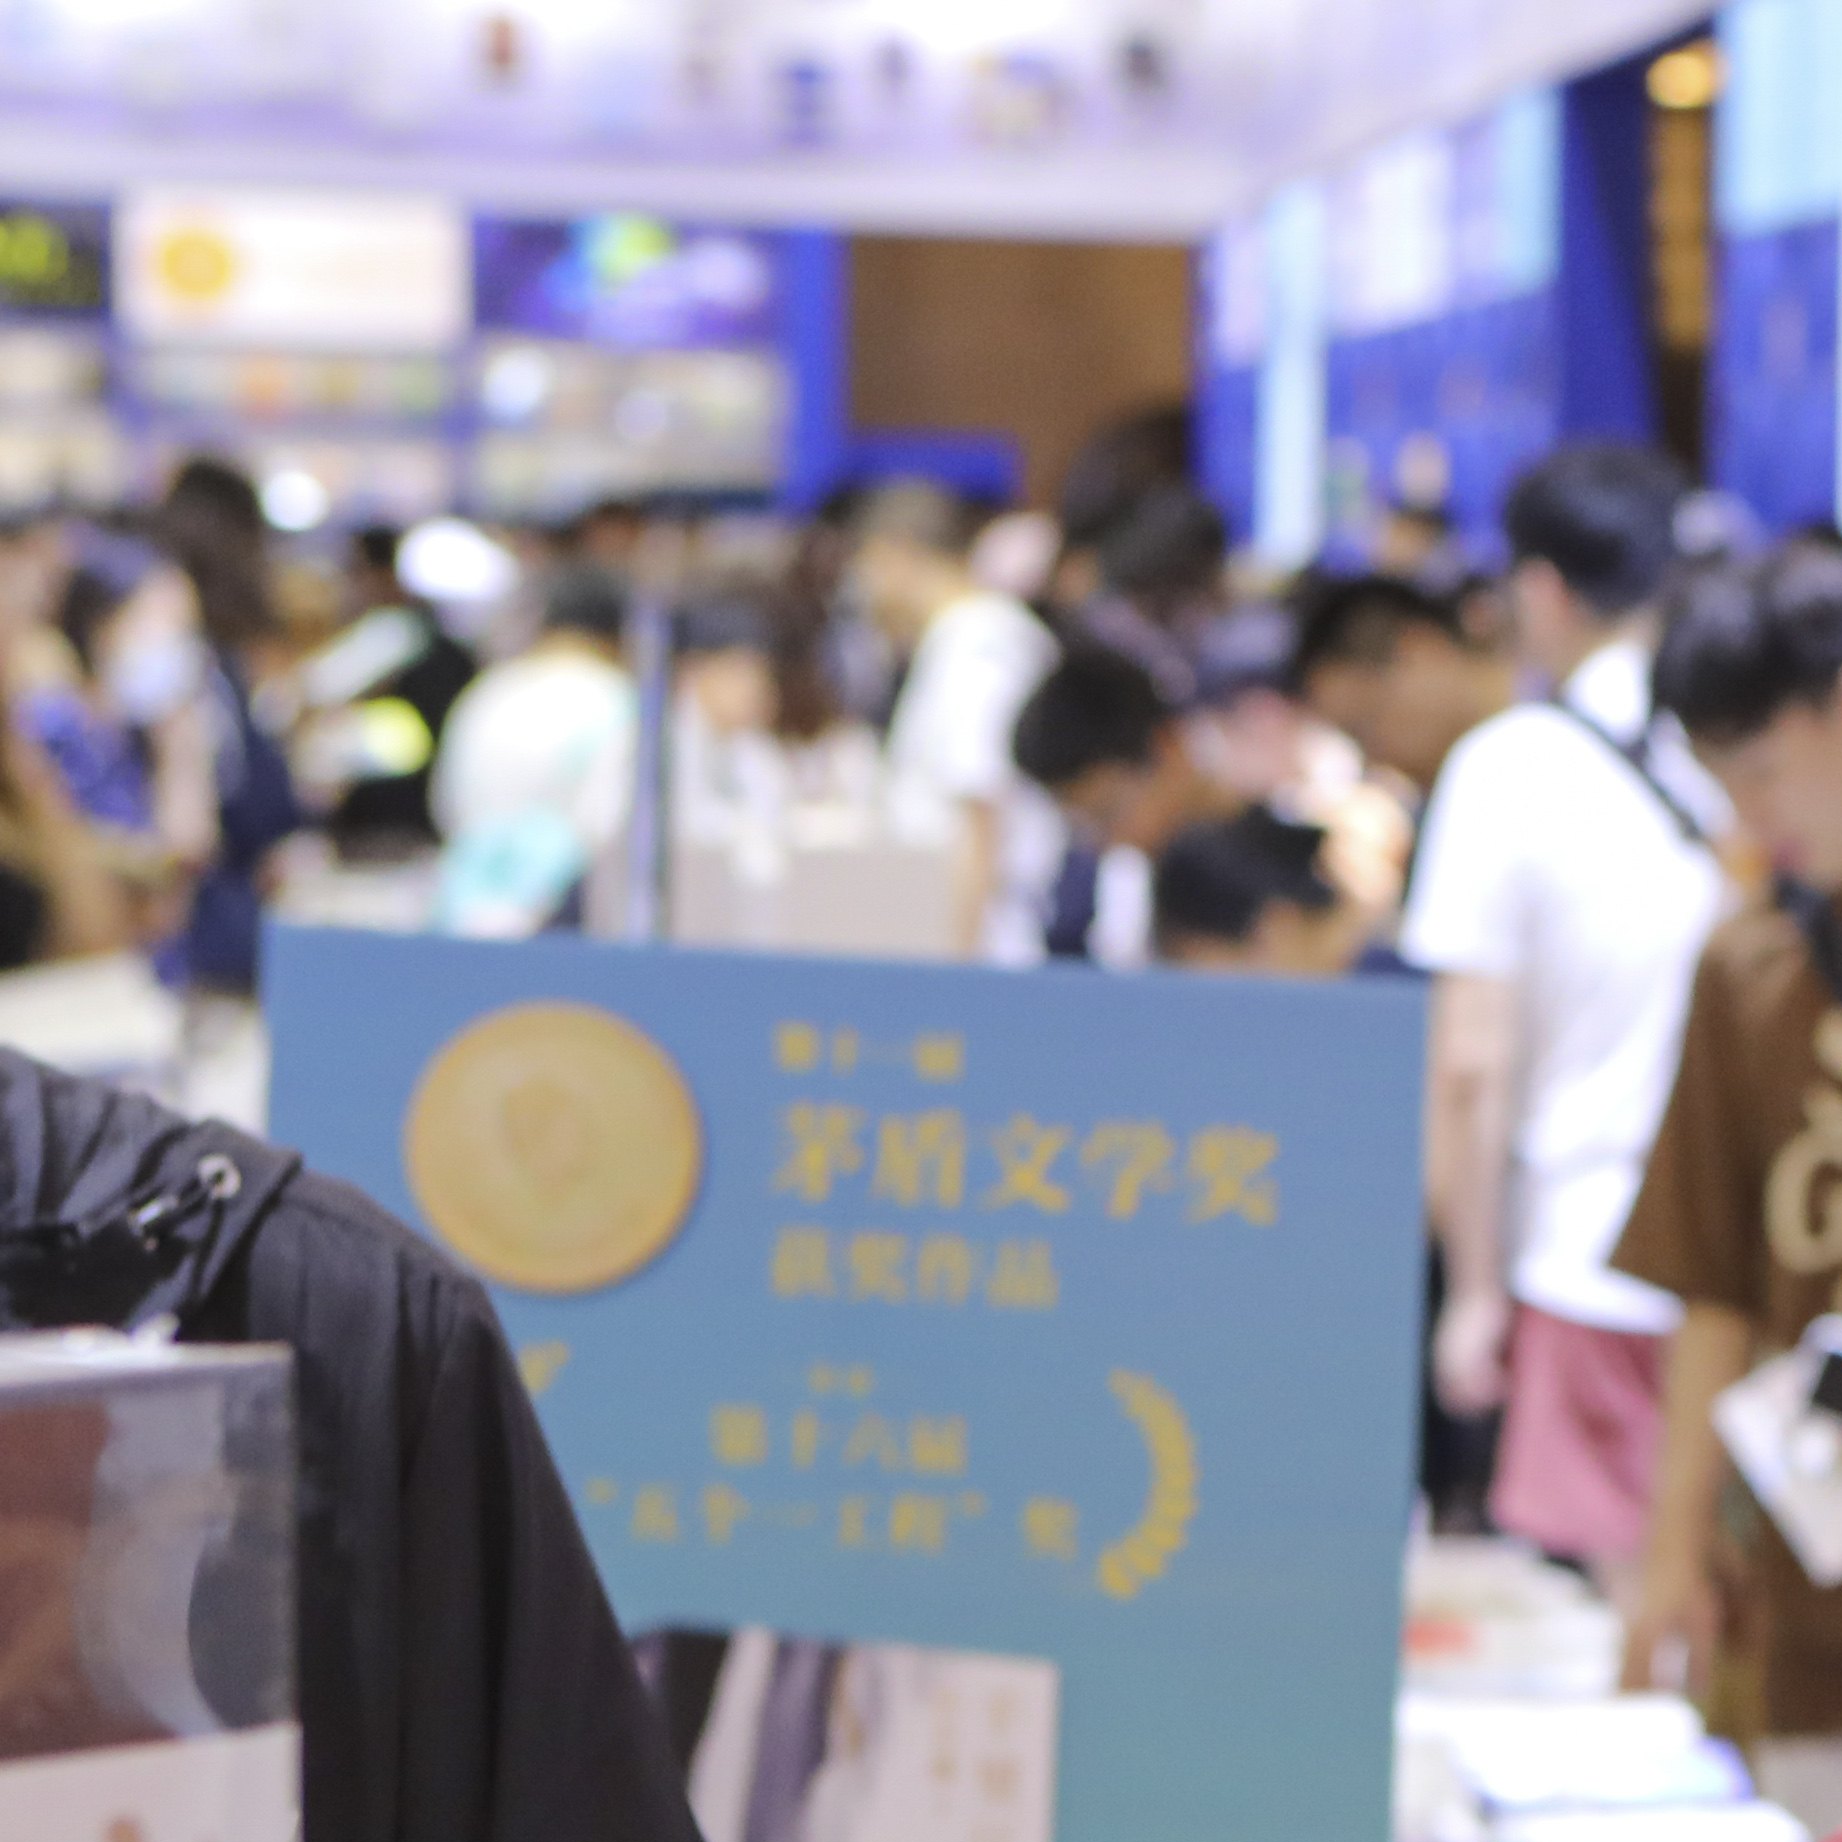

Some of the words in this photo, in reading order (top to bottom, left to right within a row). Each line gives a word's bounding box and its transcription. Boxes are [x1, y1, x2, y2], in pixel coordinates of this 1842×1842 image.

[770, 1100, 1280, 1226] 茅盾文学奖
[770, 1225, 1062, 1310] 获奖作品
